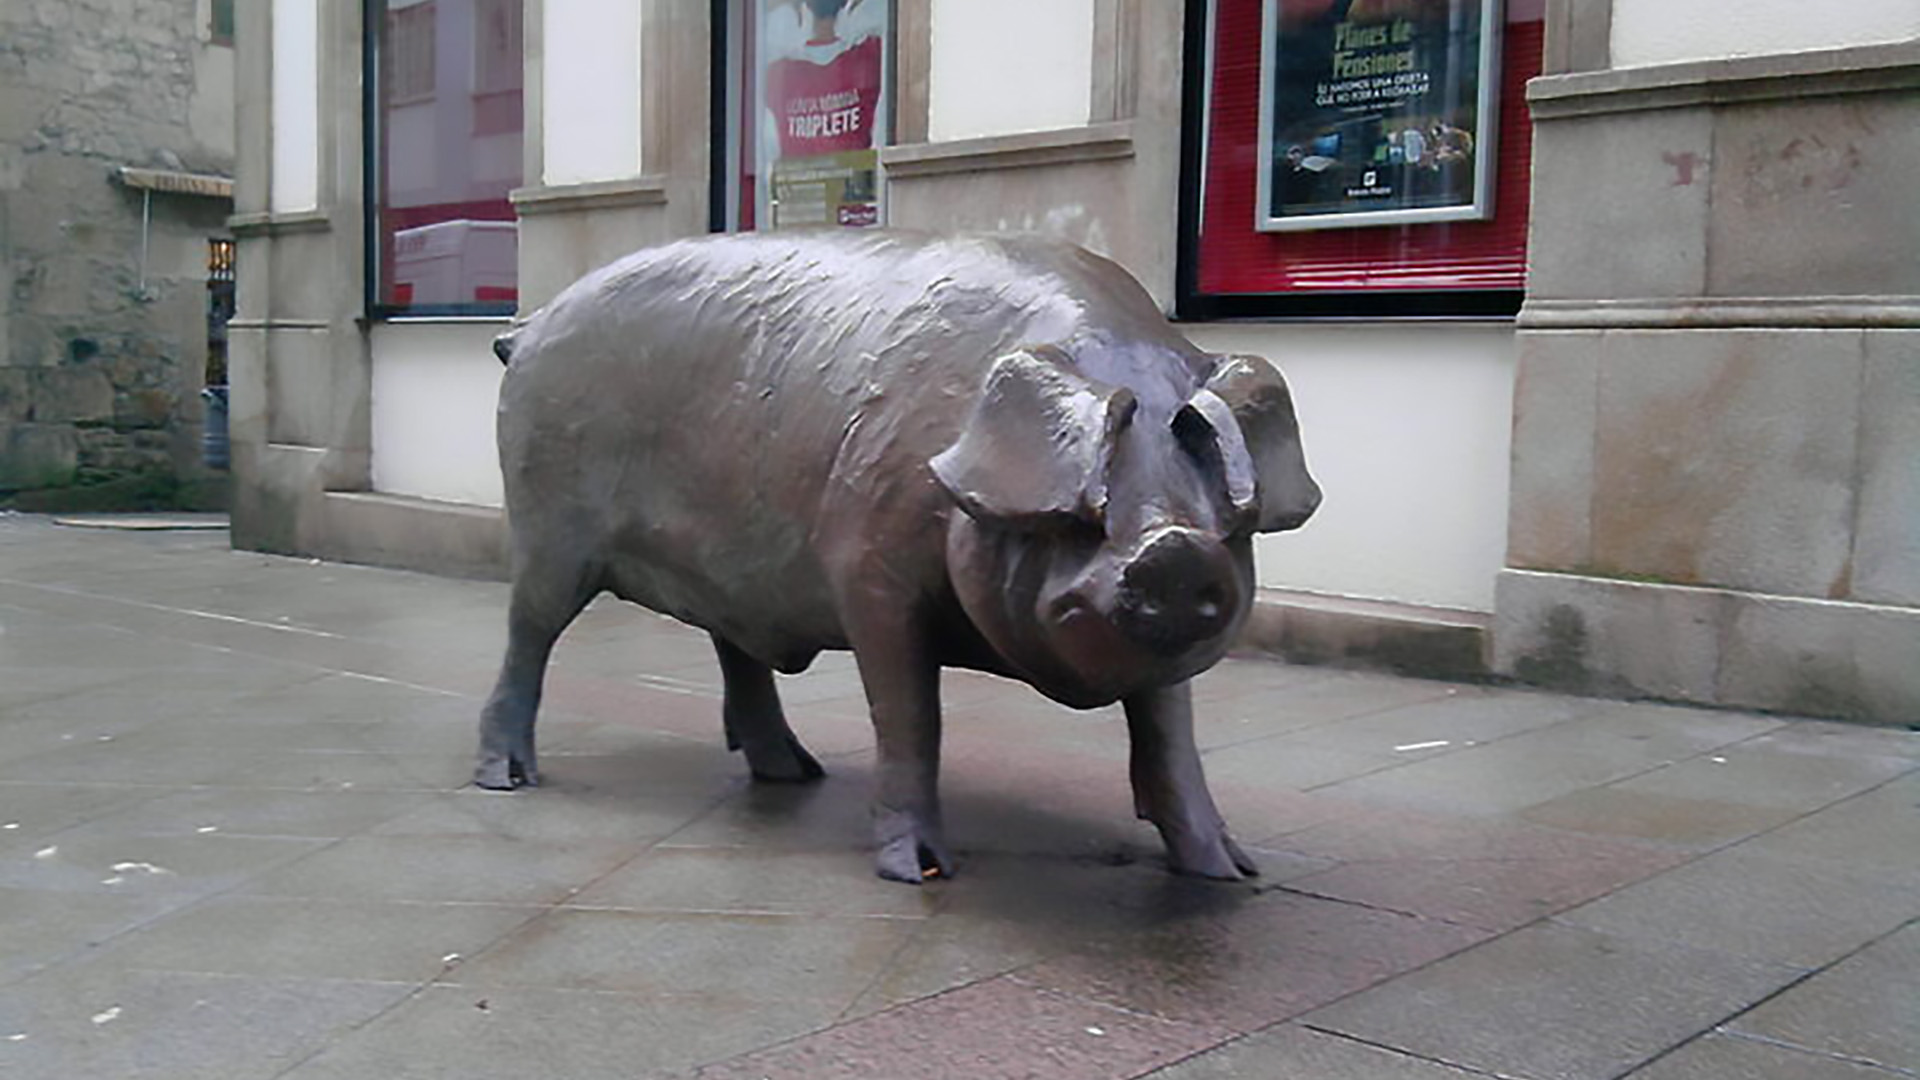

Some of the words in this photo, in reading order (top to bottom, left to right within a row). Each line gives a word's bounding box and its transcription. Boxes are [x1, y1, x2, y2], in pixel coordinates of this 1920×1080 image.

[1391, 16, 1413, 43] de
[1332, 48, 1414, 79] Pensiones
[787, 106, 861, 138] TRIPLETE
